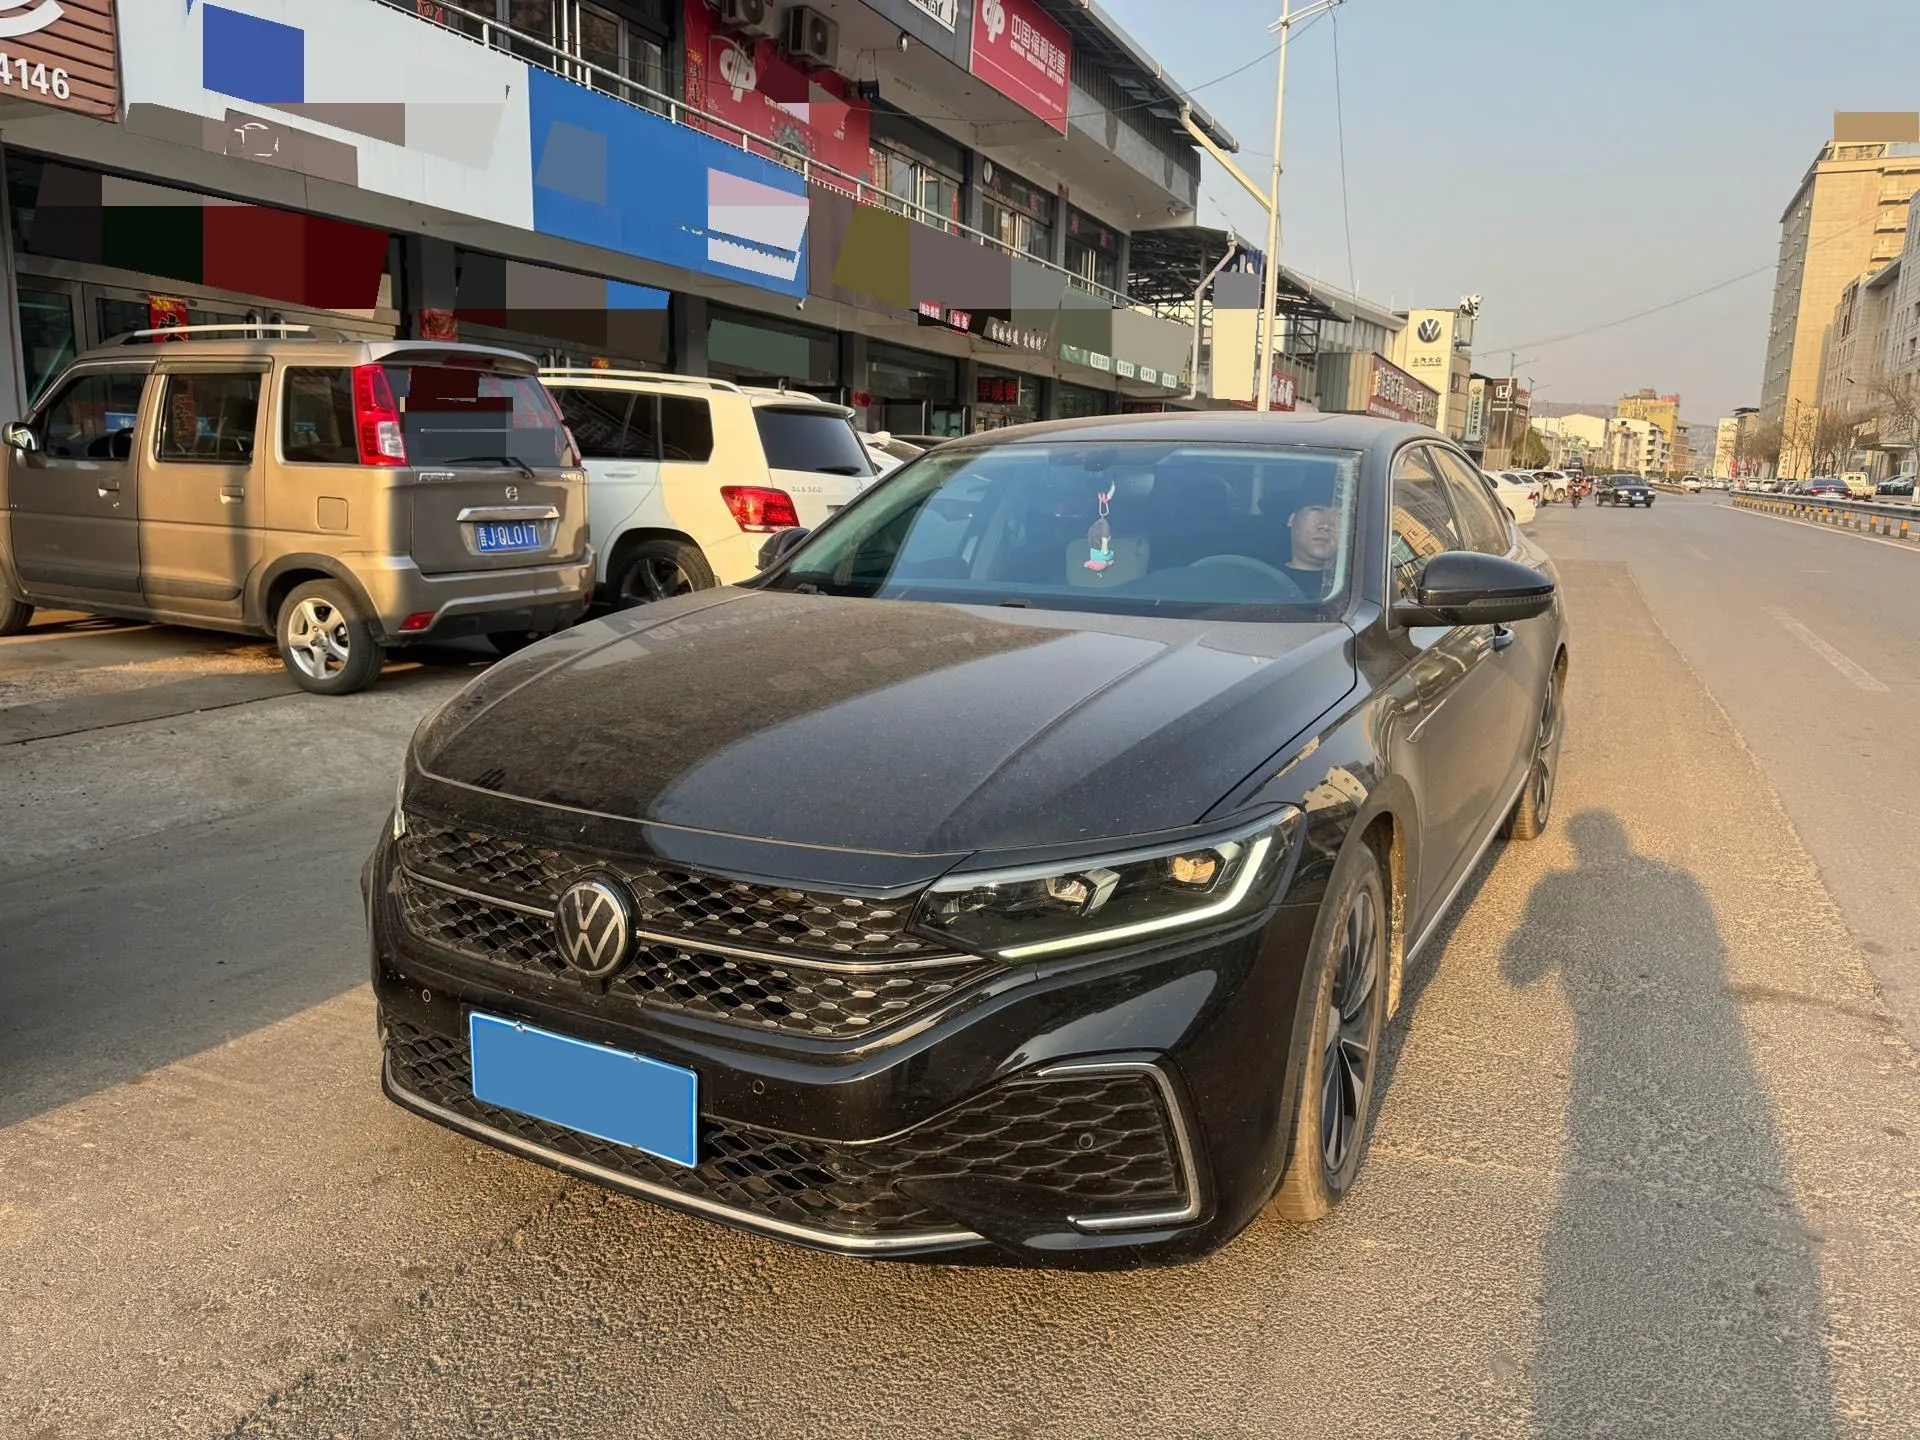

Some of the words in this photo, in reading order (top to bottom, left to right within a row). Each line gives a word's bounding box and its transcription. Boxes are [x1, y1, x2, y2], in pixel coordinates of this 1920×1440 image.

[1010, 40, 1025, 58] CHINA
[1012, 14, 1065, 77] 中国福利彩票
